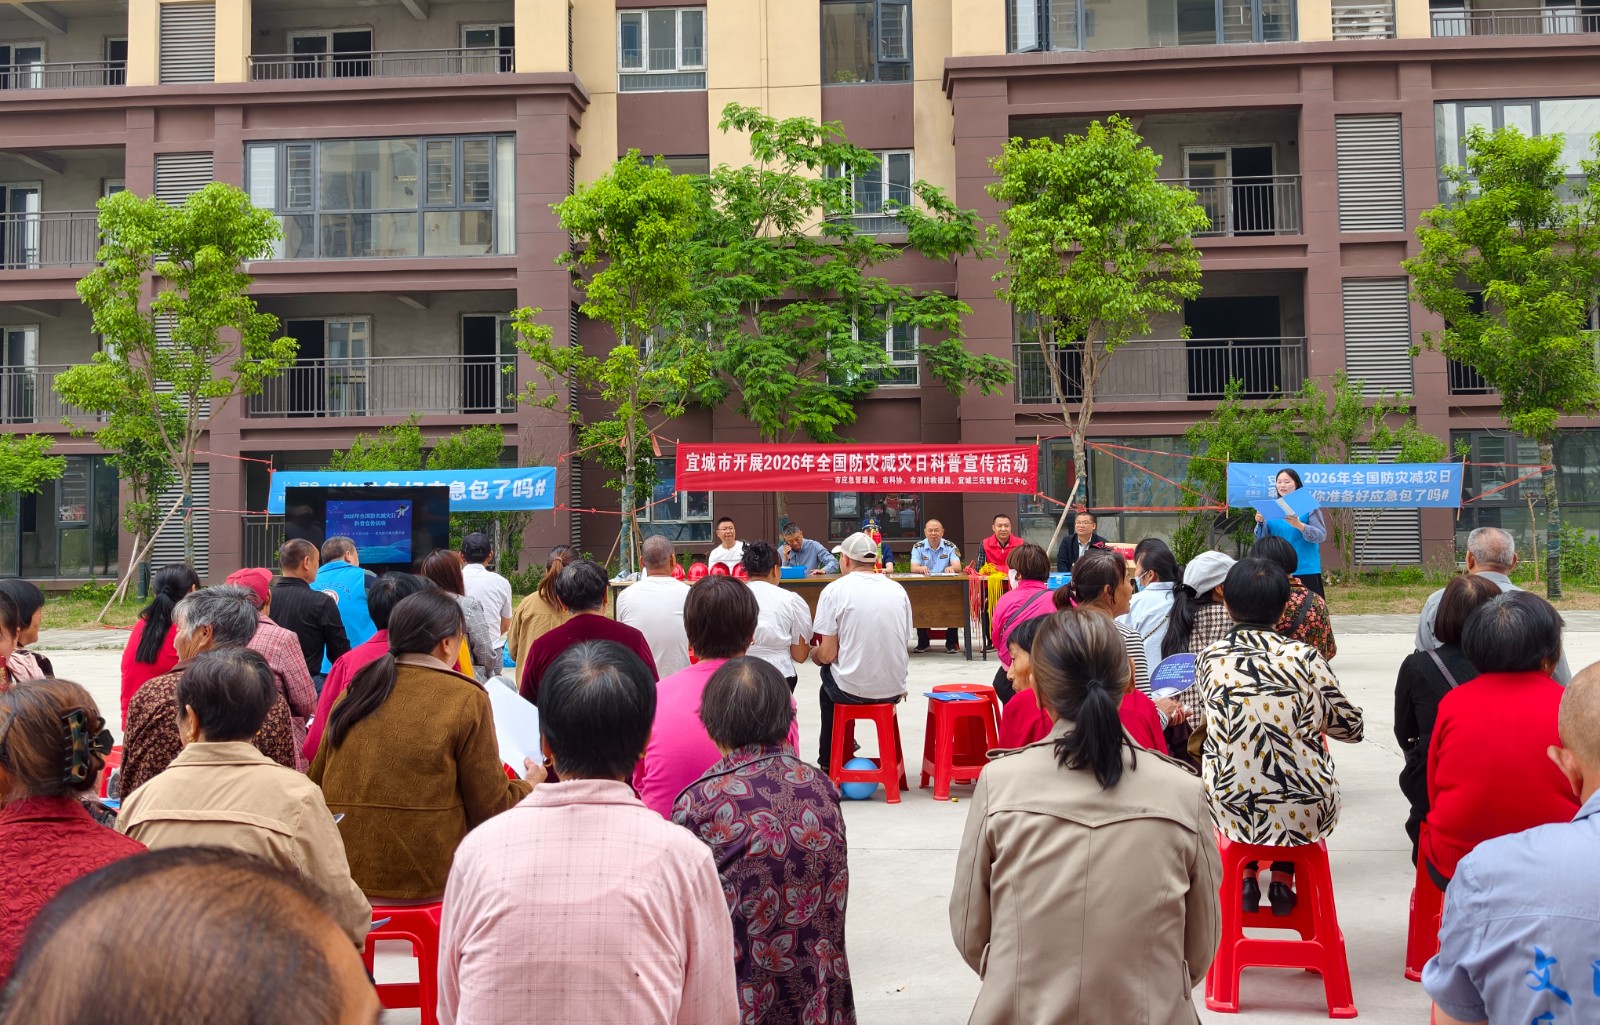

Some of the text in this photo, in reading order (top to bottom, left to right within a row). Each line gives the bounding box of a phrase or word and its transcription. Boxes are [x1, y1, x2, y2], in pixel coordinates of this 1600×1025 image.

[686, 452, 1028, 473] 宜城市开展2026年全国防灾减灾日科普宣传活动
[1304, 470, 1451, 485] 2026年全国防灾减灾日
[1309, 488, 1450, 503] 你准备好应急包了吗#
